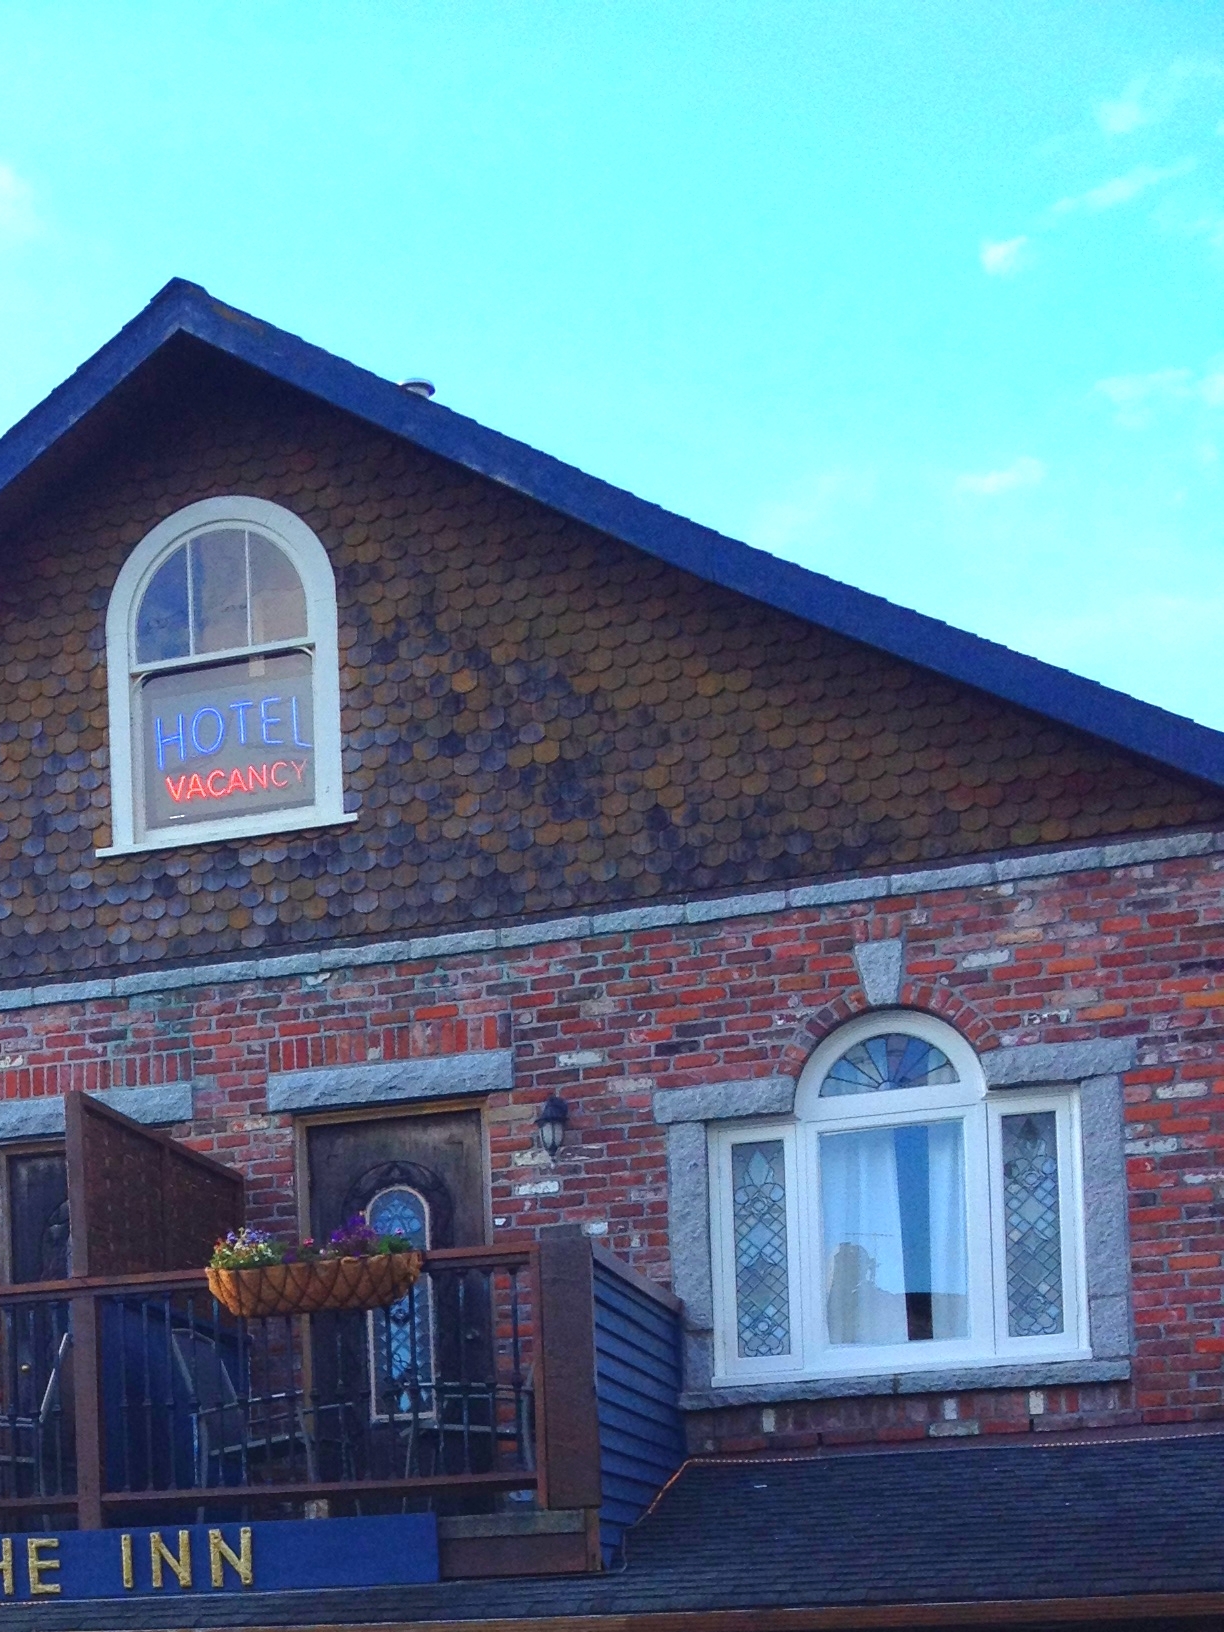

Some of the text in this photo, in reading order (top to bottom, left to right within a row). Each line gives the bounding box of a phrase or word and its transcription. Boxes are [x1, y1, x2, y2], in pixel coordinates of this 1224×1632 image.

[154, 695, 313, 771] HOTEL
[165, 758, 309, 803] VACANCY
[121, 1526, 253, 1589] INN
